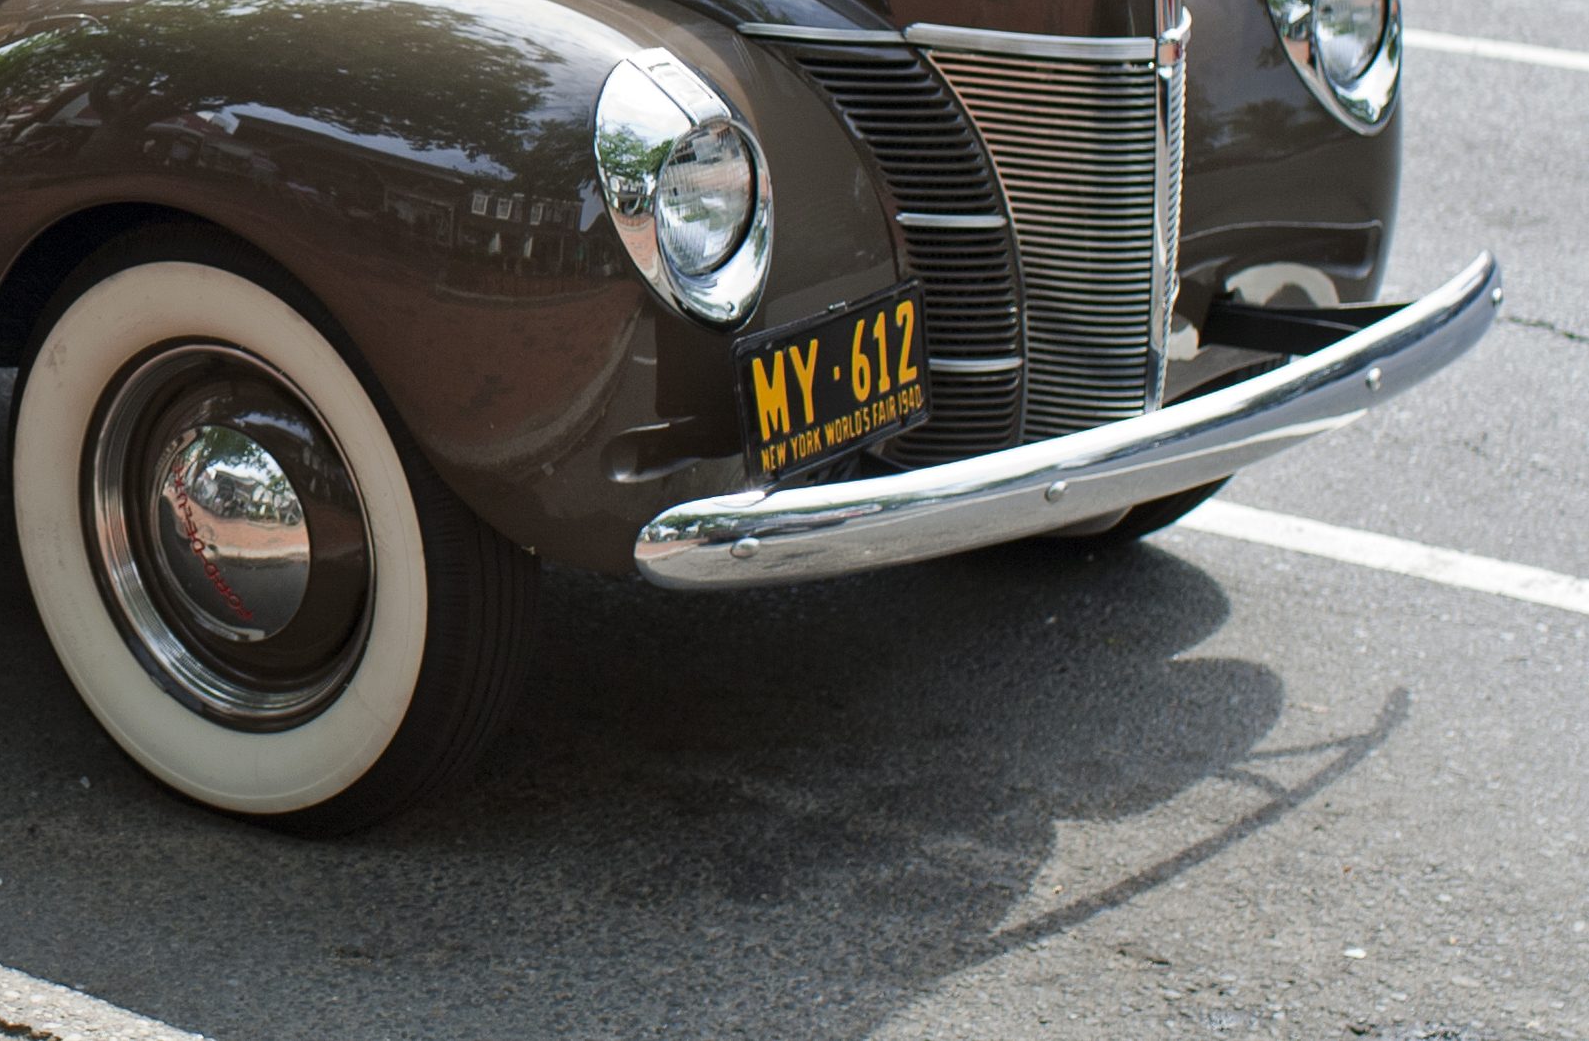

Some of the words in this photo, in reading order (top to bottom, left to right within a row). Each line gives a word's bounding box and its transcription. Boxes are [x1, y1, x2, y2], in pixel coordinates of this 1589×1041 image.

[761, 444, 786, 472] NEW
[791, 428, 822, 460] YORK
[873, 396, 896, 427] FAIR
[898, 384, 923, 416] 1940
